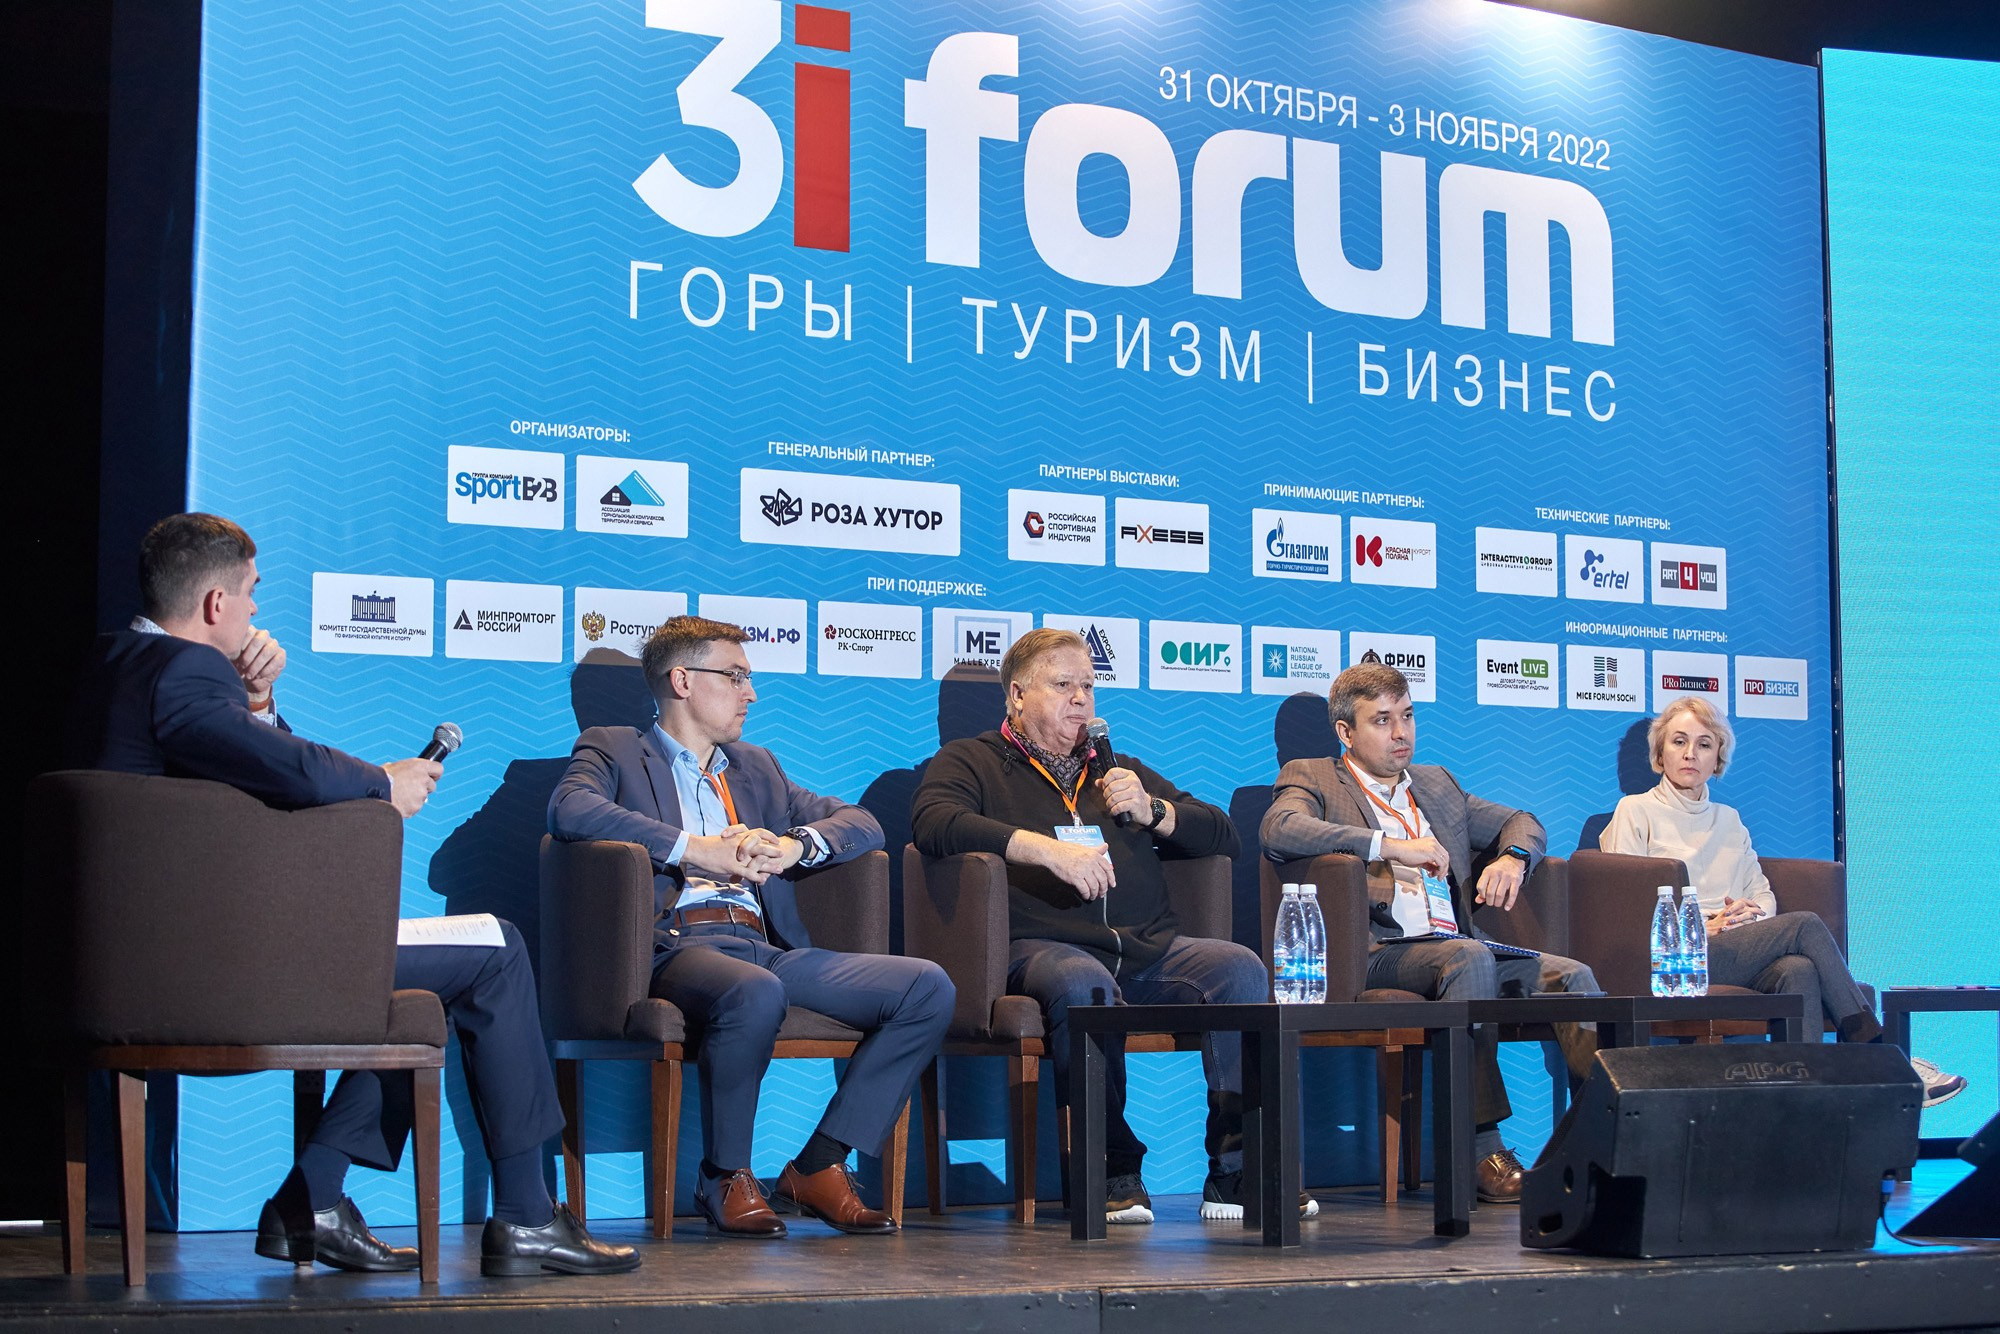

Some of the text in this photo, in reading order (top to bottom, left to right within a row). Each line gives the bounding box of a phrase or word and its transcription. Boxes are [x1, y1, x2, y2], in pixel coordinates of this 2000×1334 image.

[1158, 66, 1192, 102] 31
[1206, 73, 1357, 129] ОКТЯБРЯ
[1388, 104, 1404, 136] 3
[1415, 107, 1539, 159] НОЯБРЯ
[1547, 130, 1611, 171] 2022
[904, 31, 1616, 347] forum
[629, 259, 852, 342] ГОРЫ
[962, 295, 1262, 384] ТУРИЗМ
[1357, 342, 1618, 424] БИЗНЕС
[510, 419, 631, 443] ОРГАНИЗАТОРЫ:
[768, 441, 935, 467] ГЕНЕРАЛЬНЫЙ ПАРТНЕР:
[1039, 464, 1180, 488] ПАРТНЕРЫ ВЫСТАВКИ:
[1264, 483, 1425, 509] ПРИНИМАЮЩИЕ ПАРТНЕРЫ:
[811, 502, 943, 531] РОЗА ХУТОР
[1048, 513, 1097, 524] РОССИЙСКАЯ
[1535, 507, 1671, 531] ТЕХНИЧЕСКИЕ ПАРТНЕРЫ:
[1048, 522, 1096, 533] СПОРТИВНАЯ
[1121, 524, 1204, 545] AXESS
[1048, 532, 1091, 543] ИНДУСТРИЯ
[1285, 543, 1329, 561] ГАЗПРОМ
[1385, 546, 1411, 554] КРАСНАЯ
[1385, 553, 1409, 561] ПОЛЯНА
[1413, 548, 1431, 556] КУРОРТ
[1480, 553, 1553, 566] INTERACTIVE GROUP
[1593, 569, 1629, 590] ertel
[1662, 566, 1716, 586] ART 4 YOU
[867, 577, 987, 596] ПРИ ПОДДЕРЖКЕ:
[477, 609, 556, 624] МИНПРОМТОРГ
[319, 624, 427, 636] КОМИТЕТ ГОСУДАРСТВЕННОЙ ДУМЫ
[477, 621, 521, 633] РОССИИ
[610, 620, 659, 639] Ростур
[838, 627, 916, 642] РОСКОНГРЕСС
[1566, 621, 1728, 643] ИНФОРМАЦИОННЫЕ ПАРТНЕРЫ:
[838, 641, 873, 654] РК-Спорт
[966, 630, 1001, 655] ME
[1098, 628, 1116, 661] EXPORT
[1290, 646, 1319, 654] NATIONAL
[954, 657, 1001, 667] MALLEXPE
[1290, 654, 1316, 662] RUSSIAN
[1385, 652, 1426, 668] ФРИО
[1486, 659, 1546, 675] Event LIVE
[1290, 671, 1331, 680] INSTRUCTORS
[1745, 680, 1798, 695] ПРО БИЗНЕС
[1576, 692, 1636, 702] MICE FORUM SOCHI
